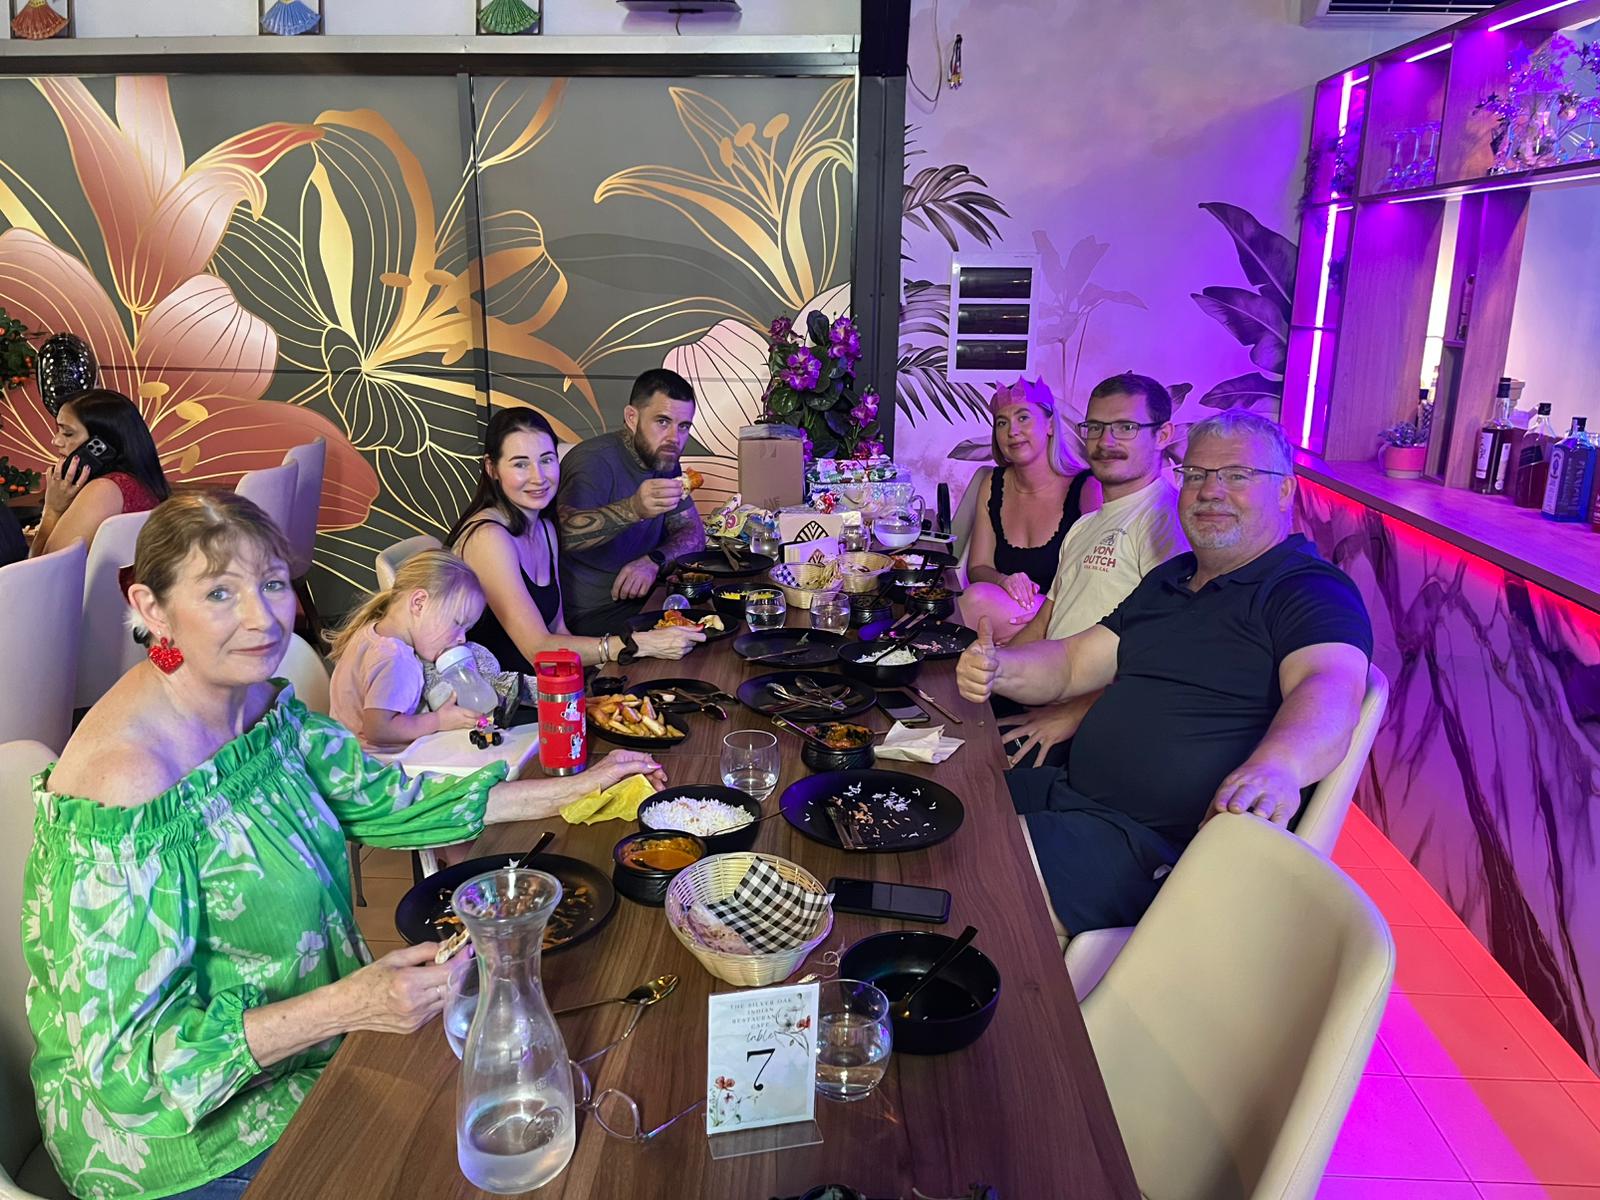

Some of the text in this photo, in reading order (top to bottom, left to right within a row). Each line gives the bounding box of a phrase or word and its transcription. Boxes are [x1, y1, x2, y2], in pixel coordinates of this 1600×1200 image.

[1093, 545, 1114, 556] VON
[1083, 555, 1116, 568] DUTCH
[747, 1007, 774, 1015] INDIAN
[745, 1029, 774, 1042] table
[746, 1048, 776, 1091] 7
